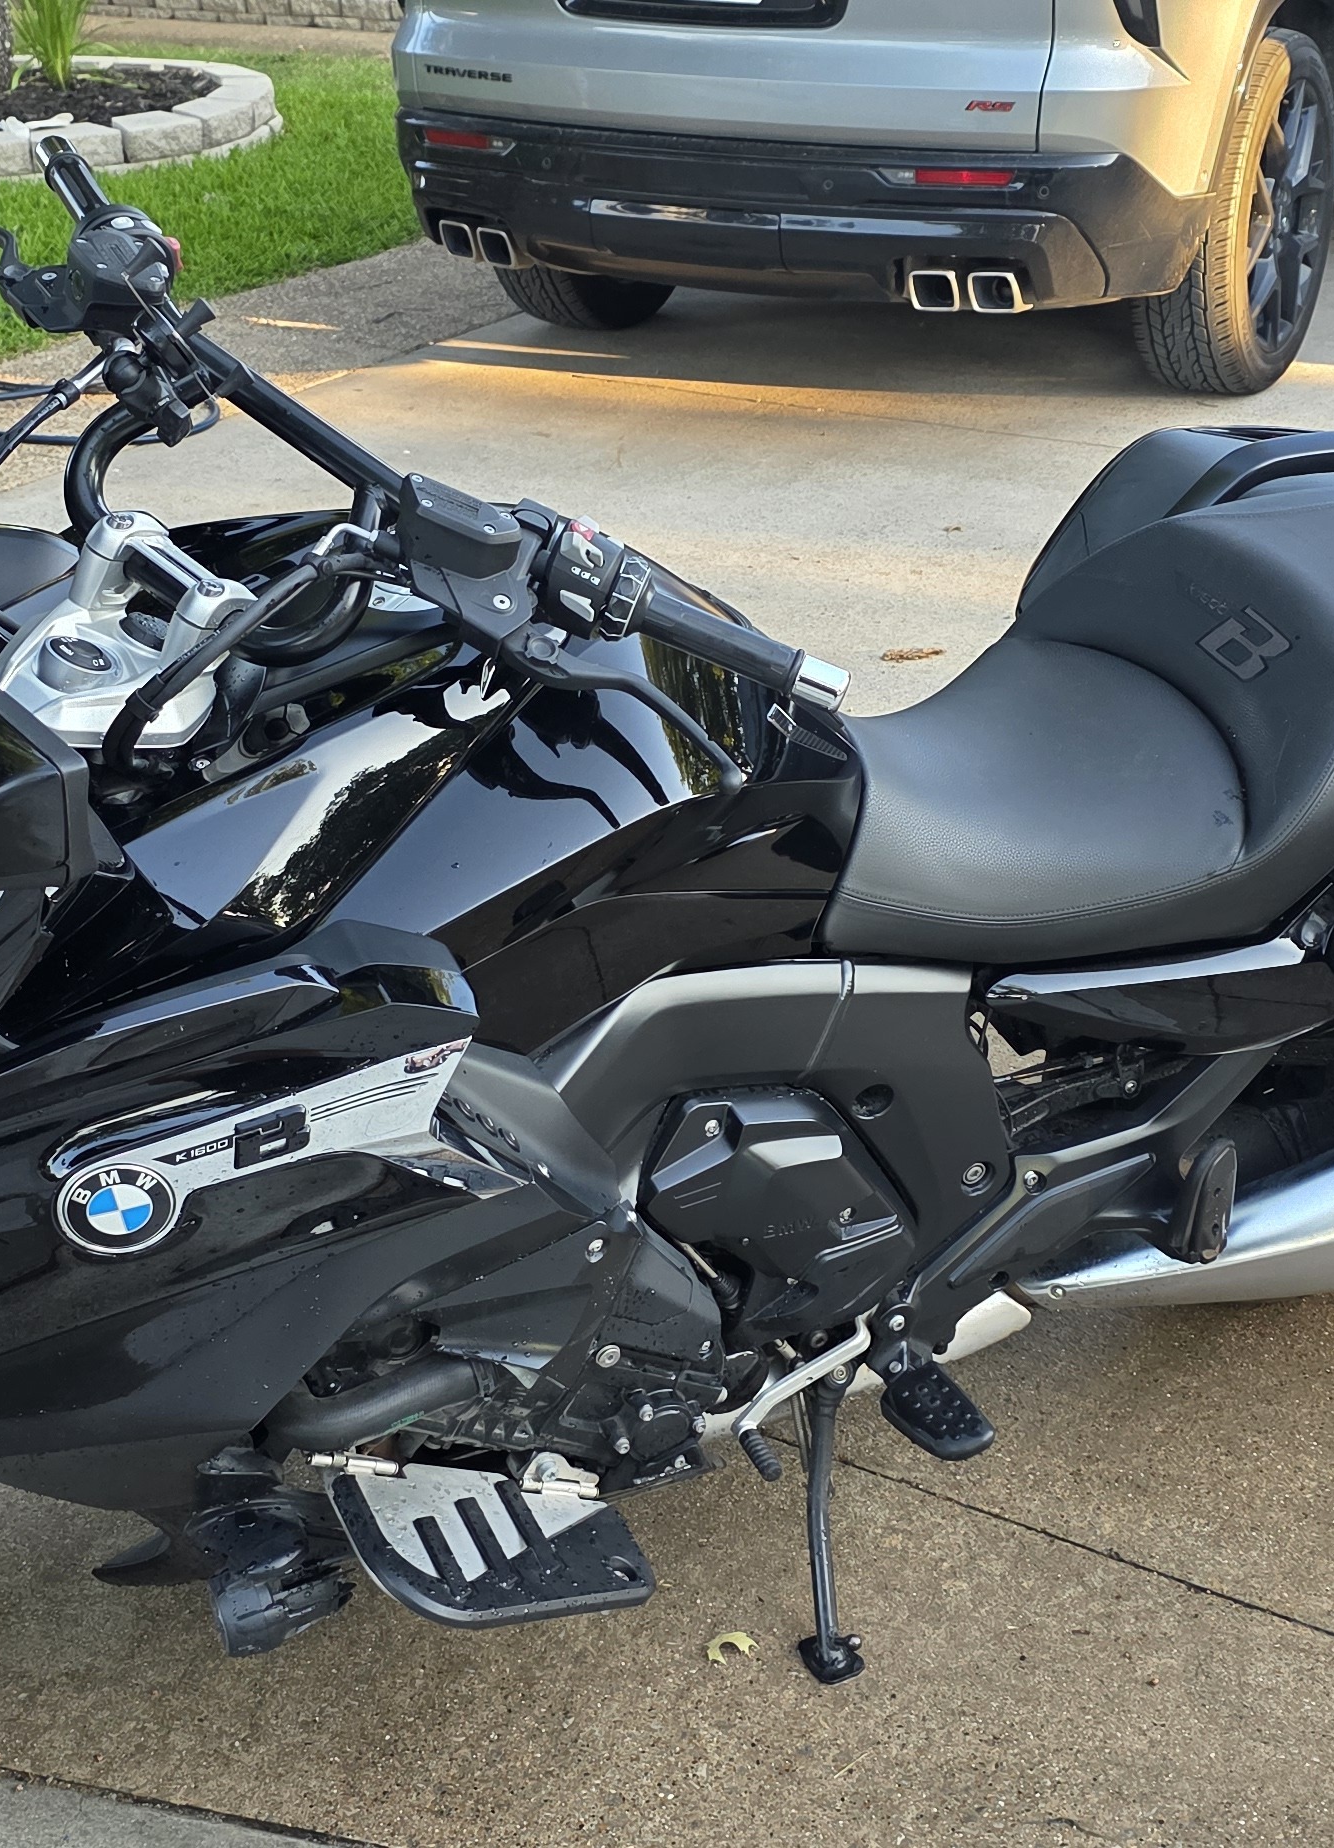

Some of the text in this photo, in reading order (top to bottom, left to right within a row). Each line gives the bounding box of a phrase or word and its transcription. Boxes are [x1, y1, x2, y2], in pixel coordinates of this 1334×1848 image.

[425, 64, 512, 82] TRAVERSE
[964, 100, 1016, 112] RS
[1196, 605, 1292, 681] B
[175, 1104, 311, 1169] K 1600 B
[70, 1169, 158, 1205] BMW
[763, 1217, 814, 1238] BMW
